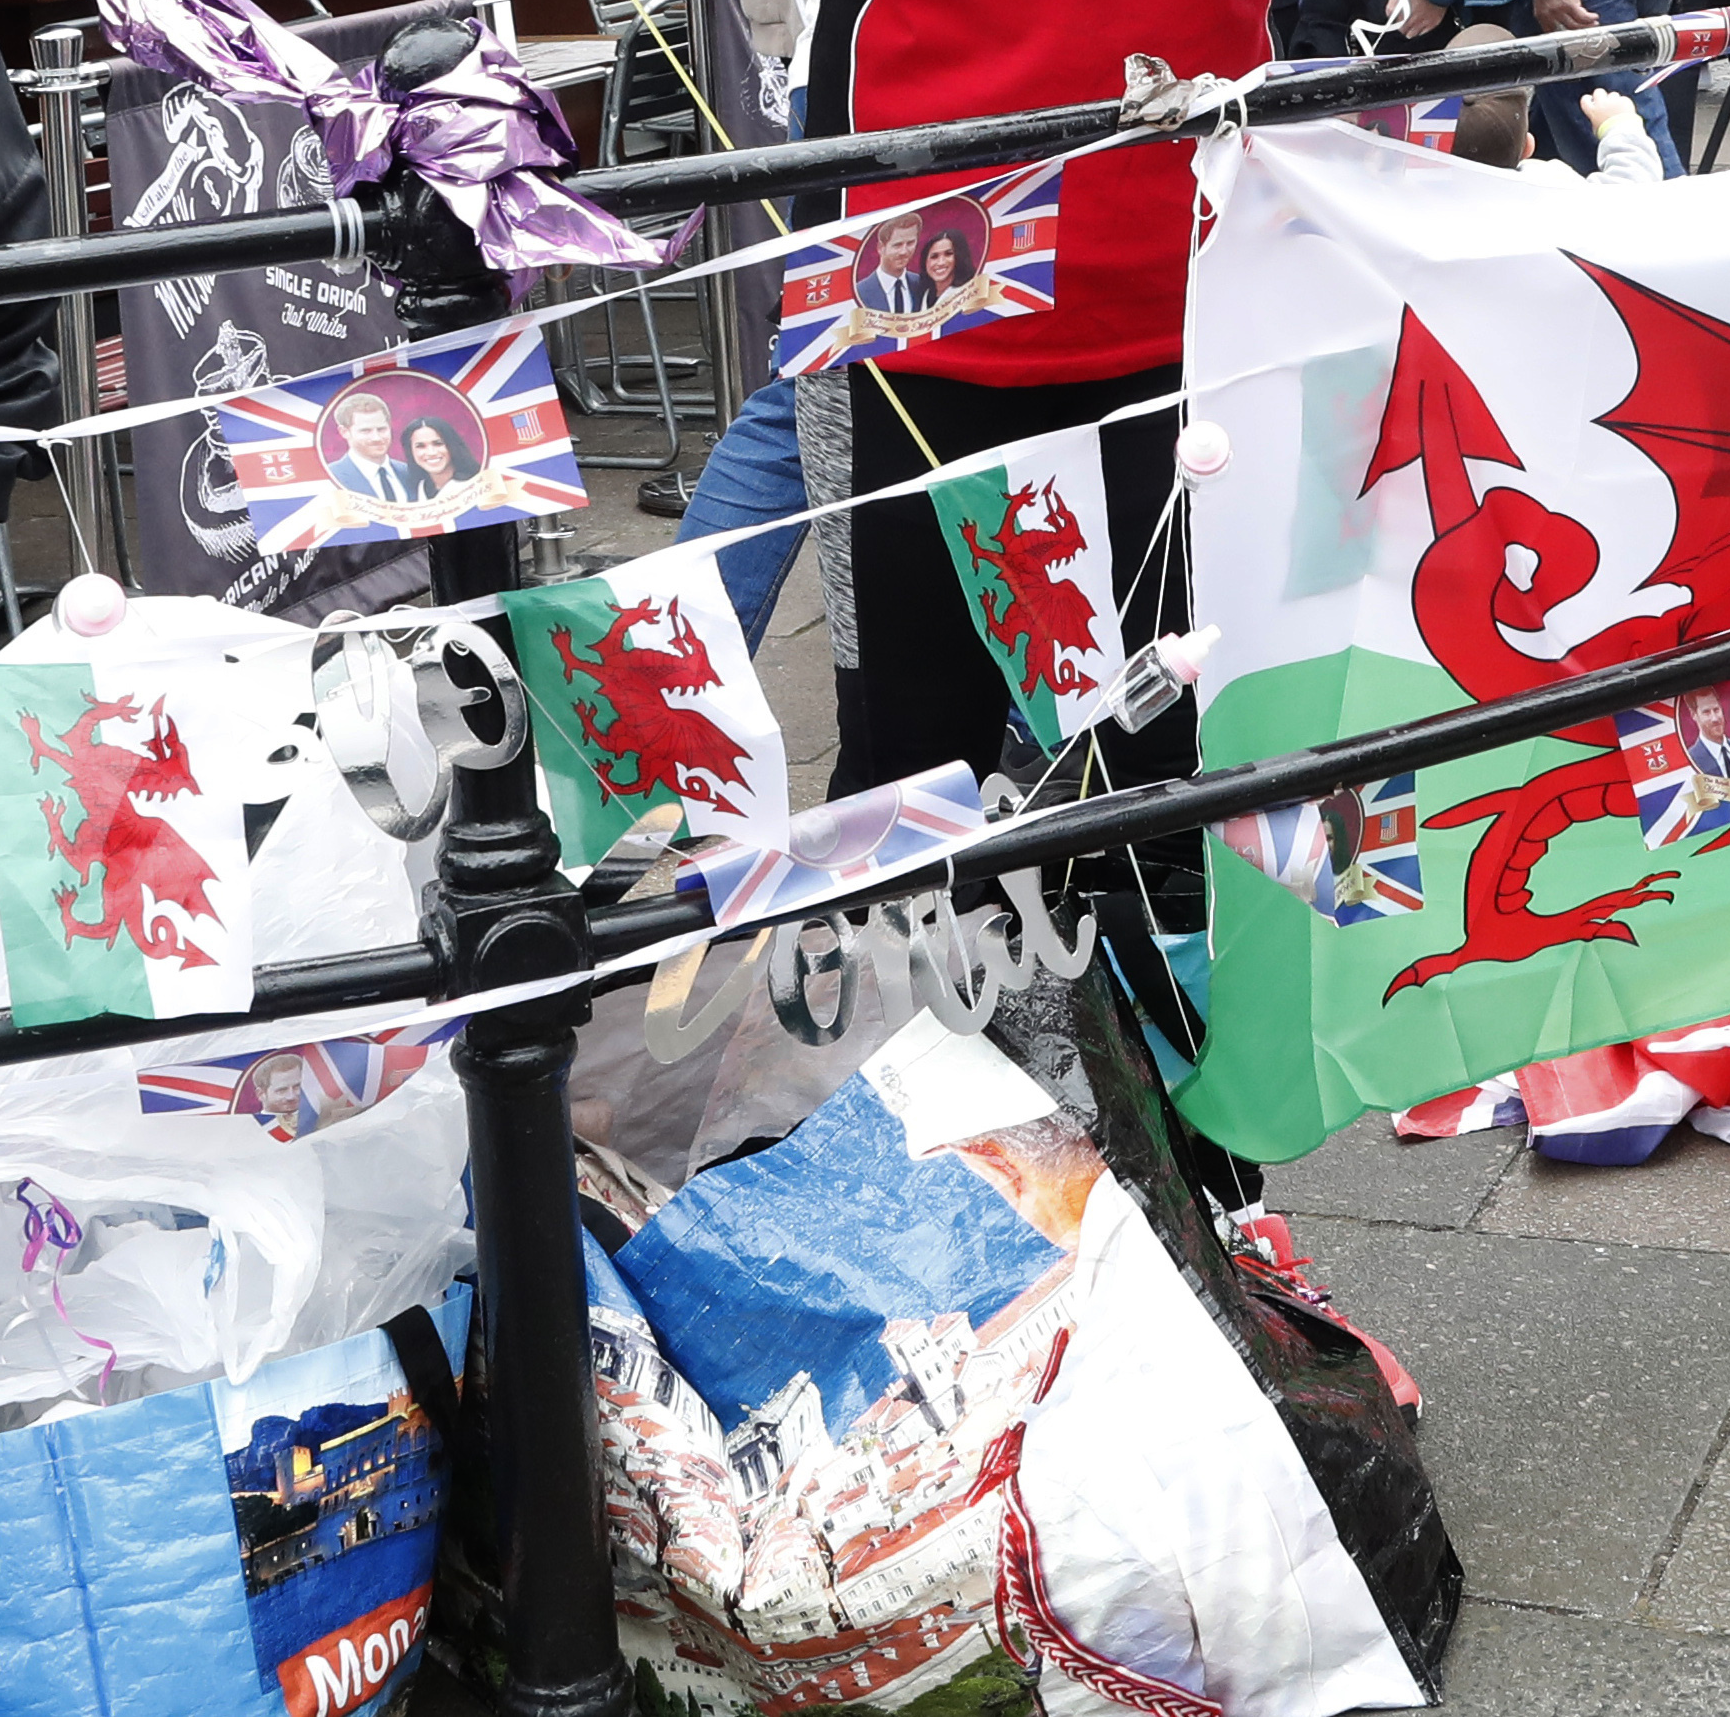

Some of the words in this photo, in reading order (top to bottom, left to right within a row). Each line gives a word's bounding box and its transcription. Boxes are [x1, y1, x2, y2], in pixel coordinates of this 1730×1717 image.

[265, 266, 312, 300] SINGLE
[316, 283, 367, 316] ORIGIN
[281, 302, 305, 328] Flat
[305, 308, 348, 340] Whites
[345, 502, 386, 521] Harry
[412, 505, 462, 523] Meghan
[462, 482, 493, 505] 2018
[305, 1594, 432, 1717] Mona
